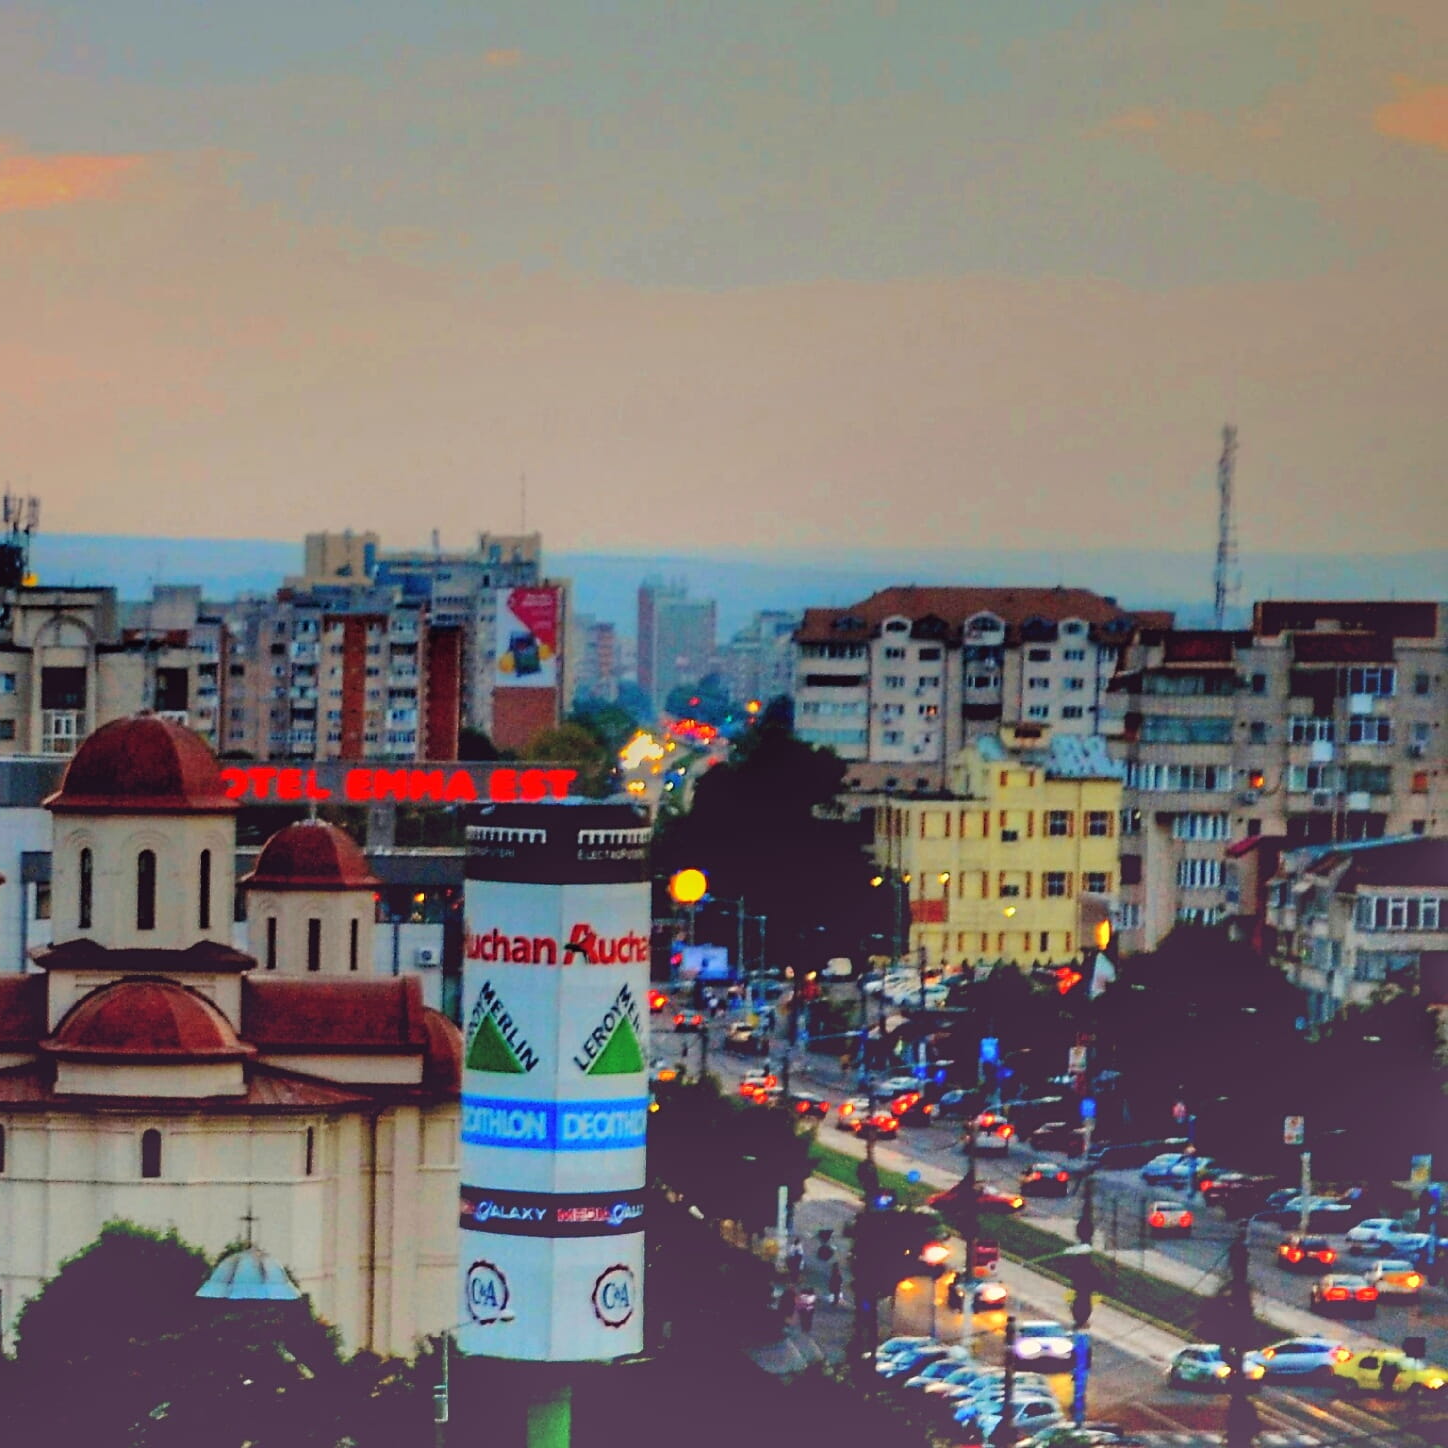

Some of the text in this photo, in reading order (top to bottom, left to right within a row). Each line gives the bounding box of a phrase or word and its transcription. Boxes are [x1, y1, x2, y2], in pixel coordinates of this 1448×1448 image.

[221, 767, 578, 802] OTEL EMMA EST
[466, 928, 558, 965] uchan
[481, 979, 540, 1073] MERLIN
[573, 993, 623, 1072] LEROY
